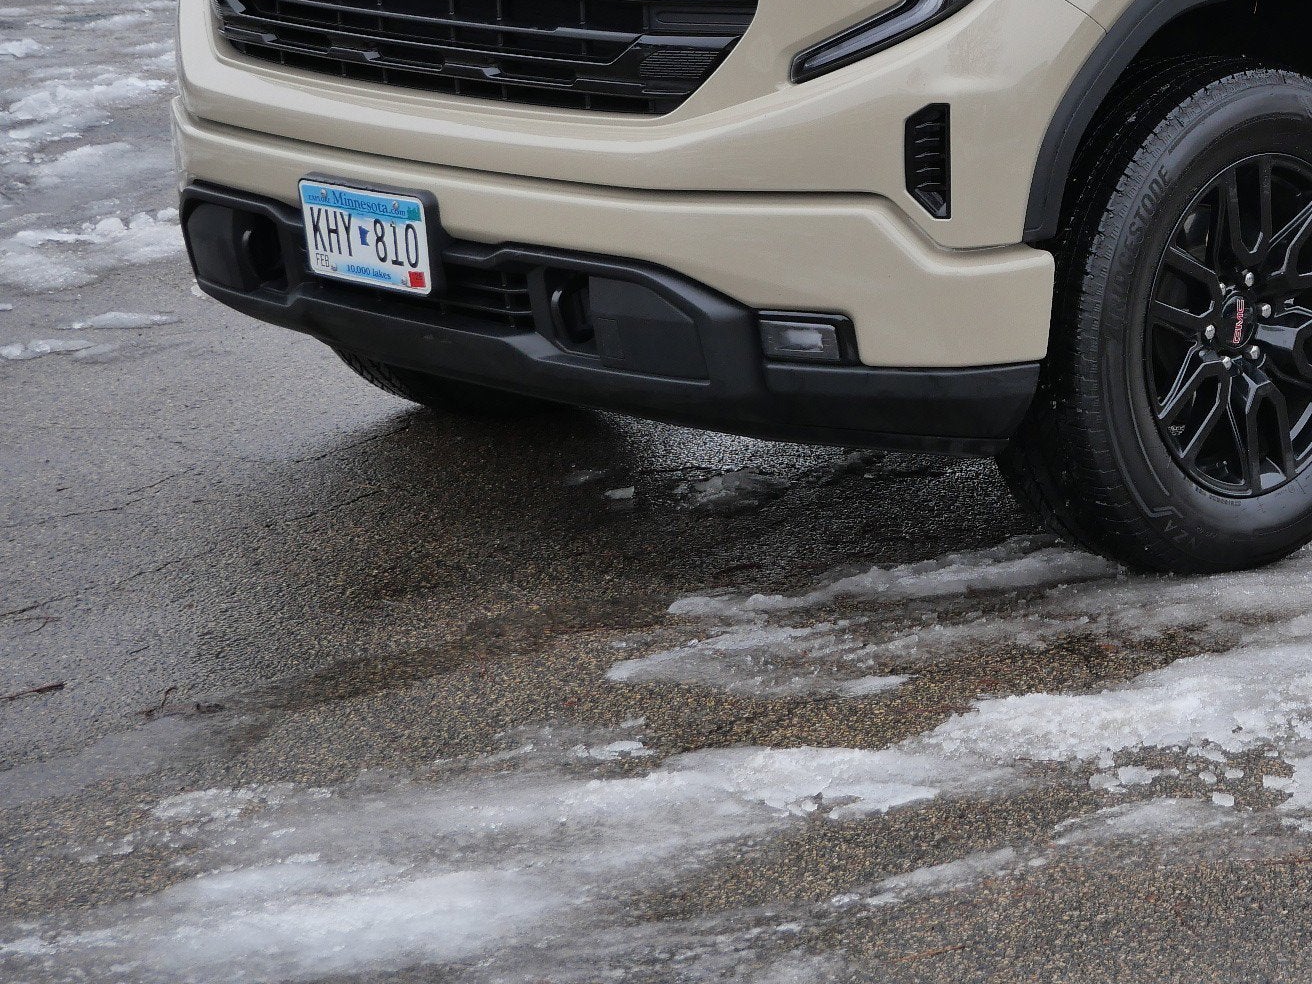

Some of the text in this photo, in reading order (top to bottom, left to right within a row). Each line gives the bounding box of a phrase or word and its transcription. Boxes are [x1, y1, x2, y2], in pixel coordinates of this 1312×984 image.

[309, 206, 420, 269] KHY 810
[346, 265, 371, 277] 10,000
[373, 269, 392, 280] lakes
[1232, 298, 1245, 345] GMC
